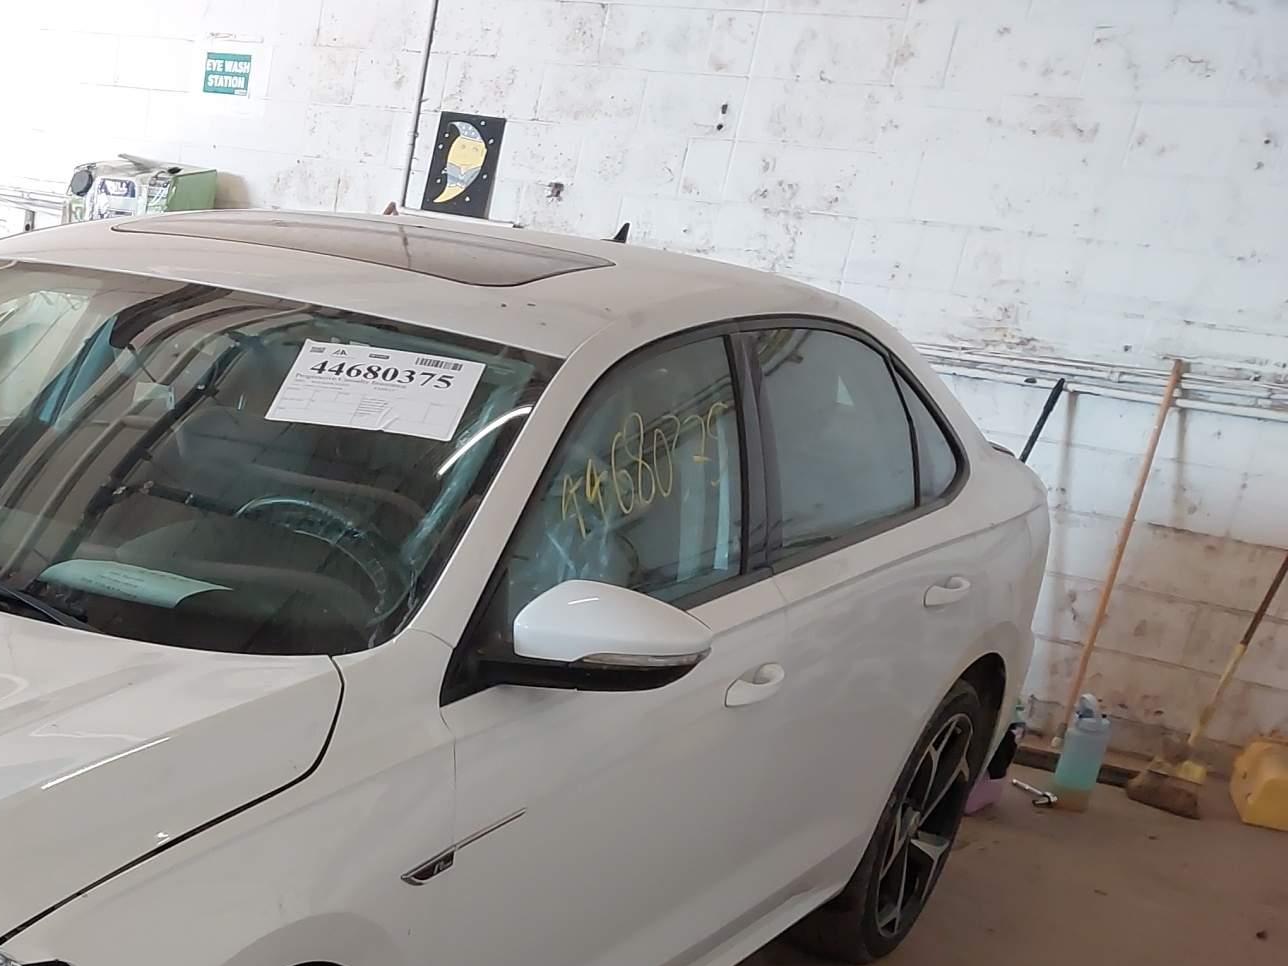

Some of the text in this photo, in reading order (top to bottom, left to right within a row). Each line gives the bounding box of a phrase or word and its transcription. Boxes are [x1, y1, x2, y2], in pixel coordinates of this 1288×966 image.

[206, 59, 250, 73] EYE WASH
[207, 74, 245, 88] STATION
[310, 360, 454, 389] 44680375
